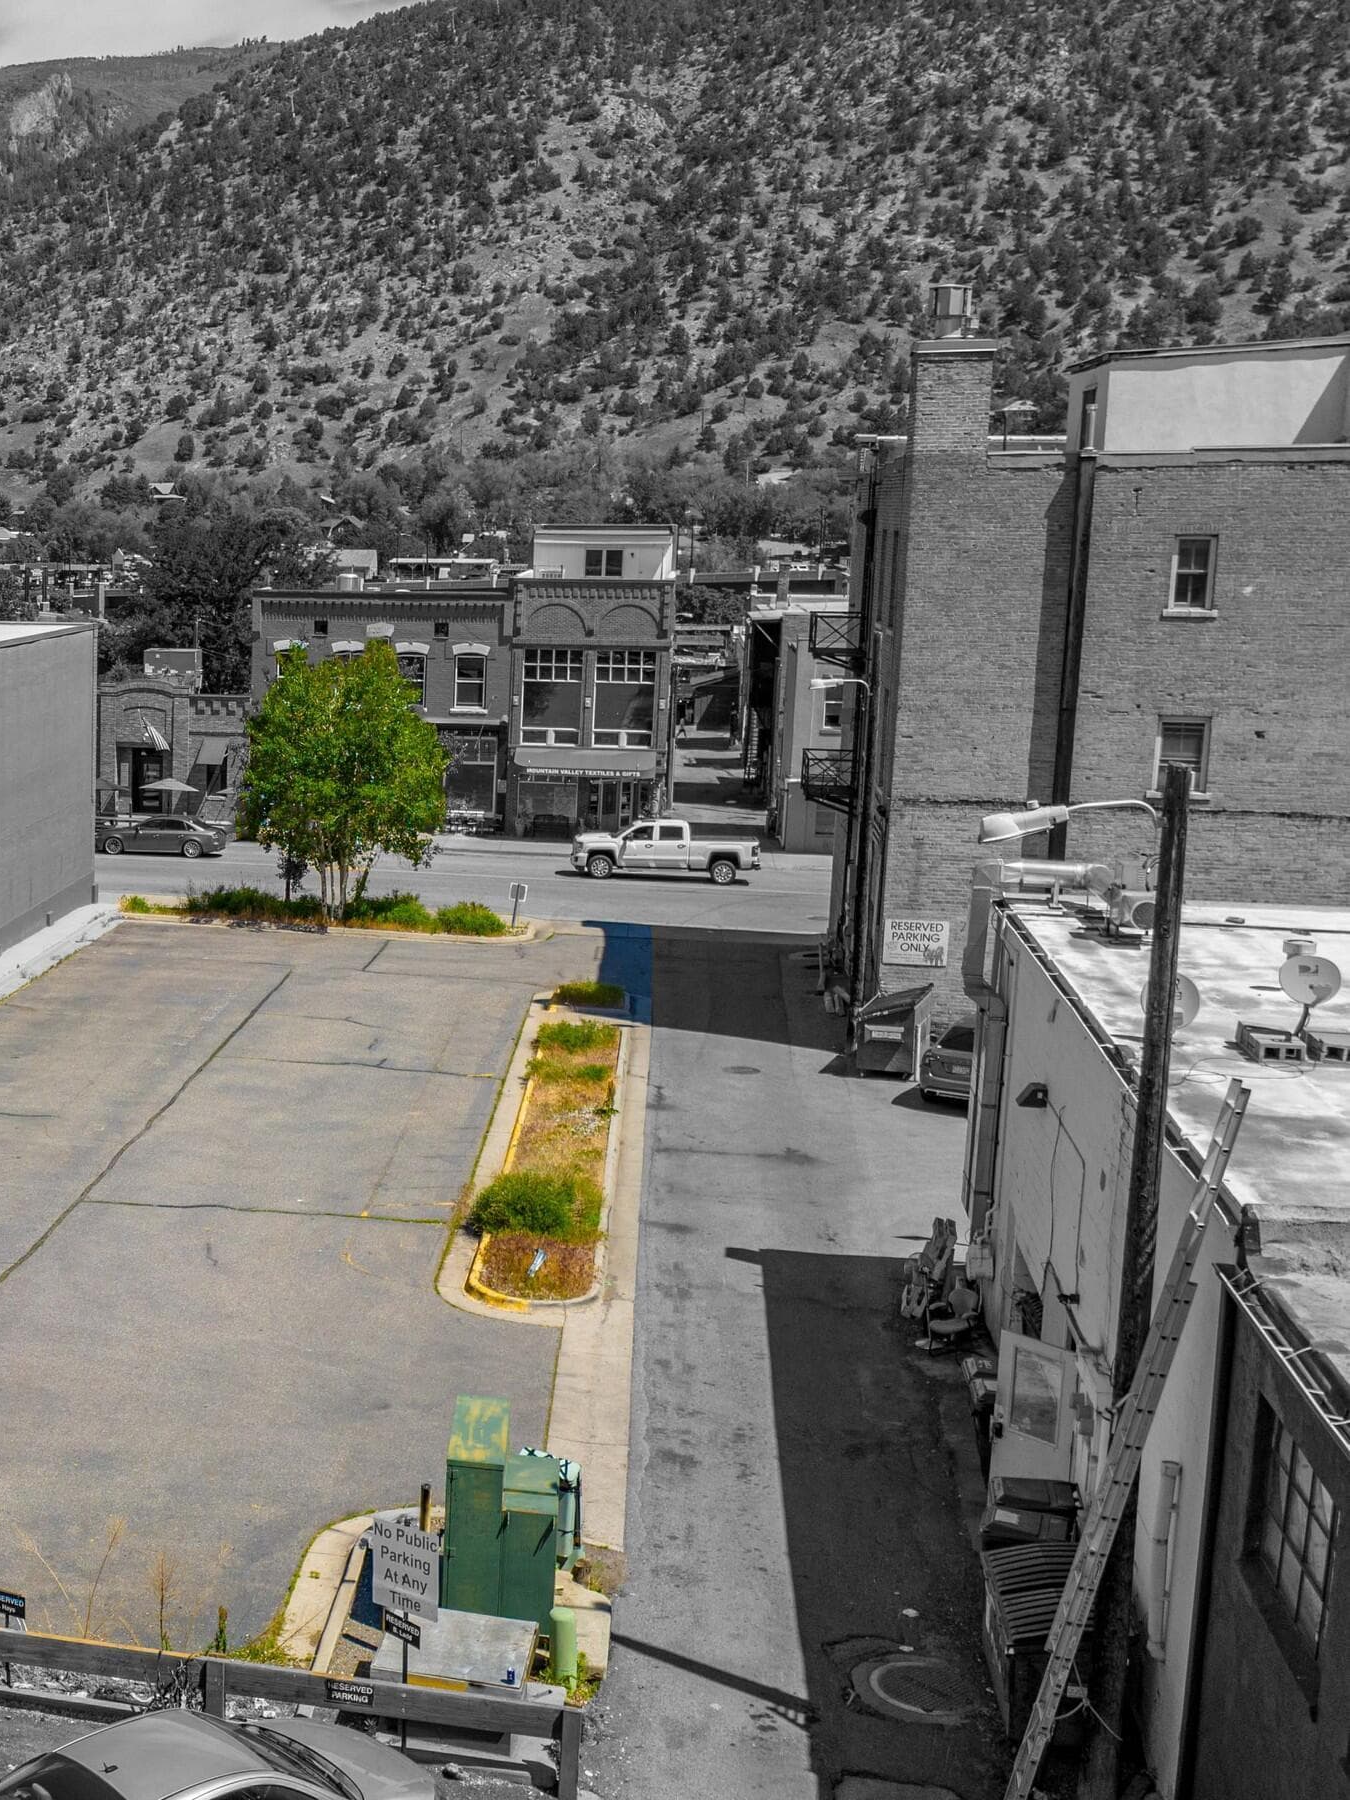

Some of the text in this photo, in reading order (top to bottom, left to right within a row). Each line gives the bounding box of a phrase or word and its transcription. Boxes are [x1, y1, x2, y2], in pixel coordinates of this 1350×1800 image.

[890, 921, 944, 932] RESERVED
[891, 932, 941, 943] PARKING
[900, 942, 930, 953] ONLY
[374, 1521, 437, 1553] No Public
[380, 1545, 430, 1575] Parking
[384, 1567, 428, 1595] At Any
[389, 1590, 421, 1612] Time
[385, 1614, 420, 1638] RESERVED
[331, 1690, 369, 1703] PARKING
